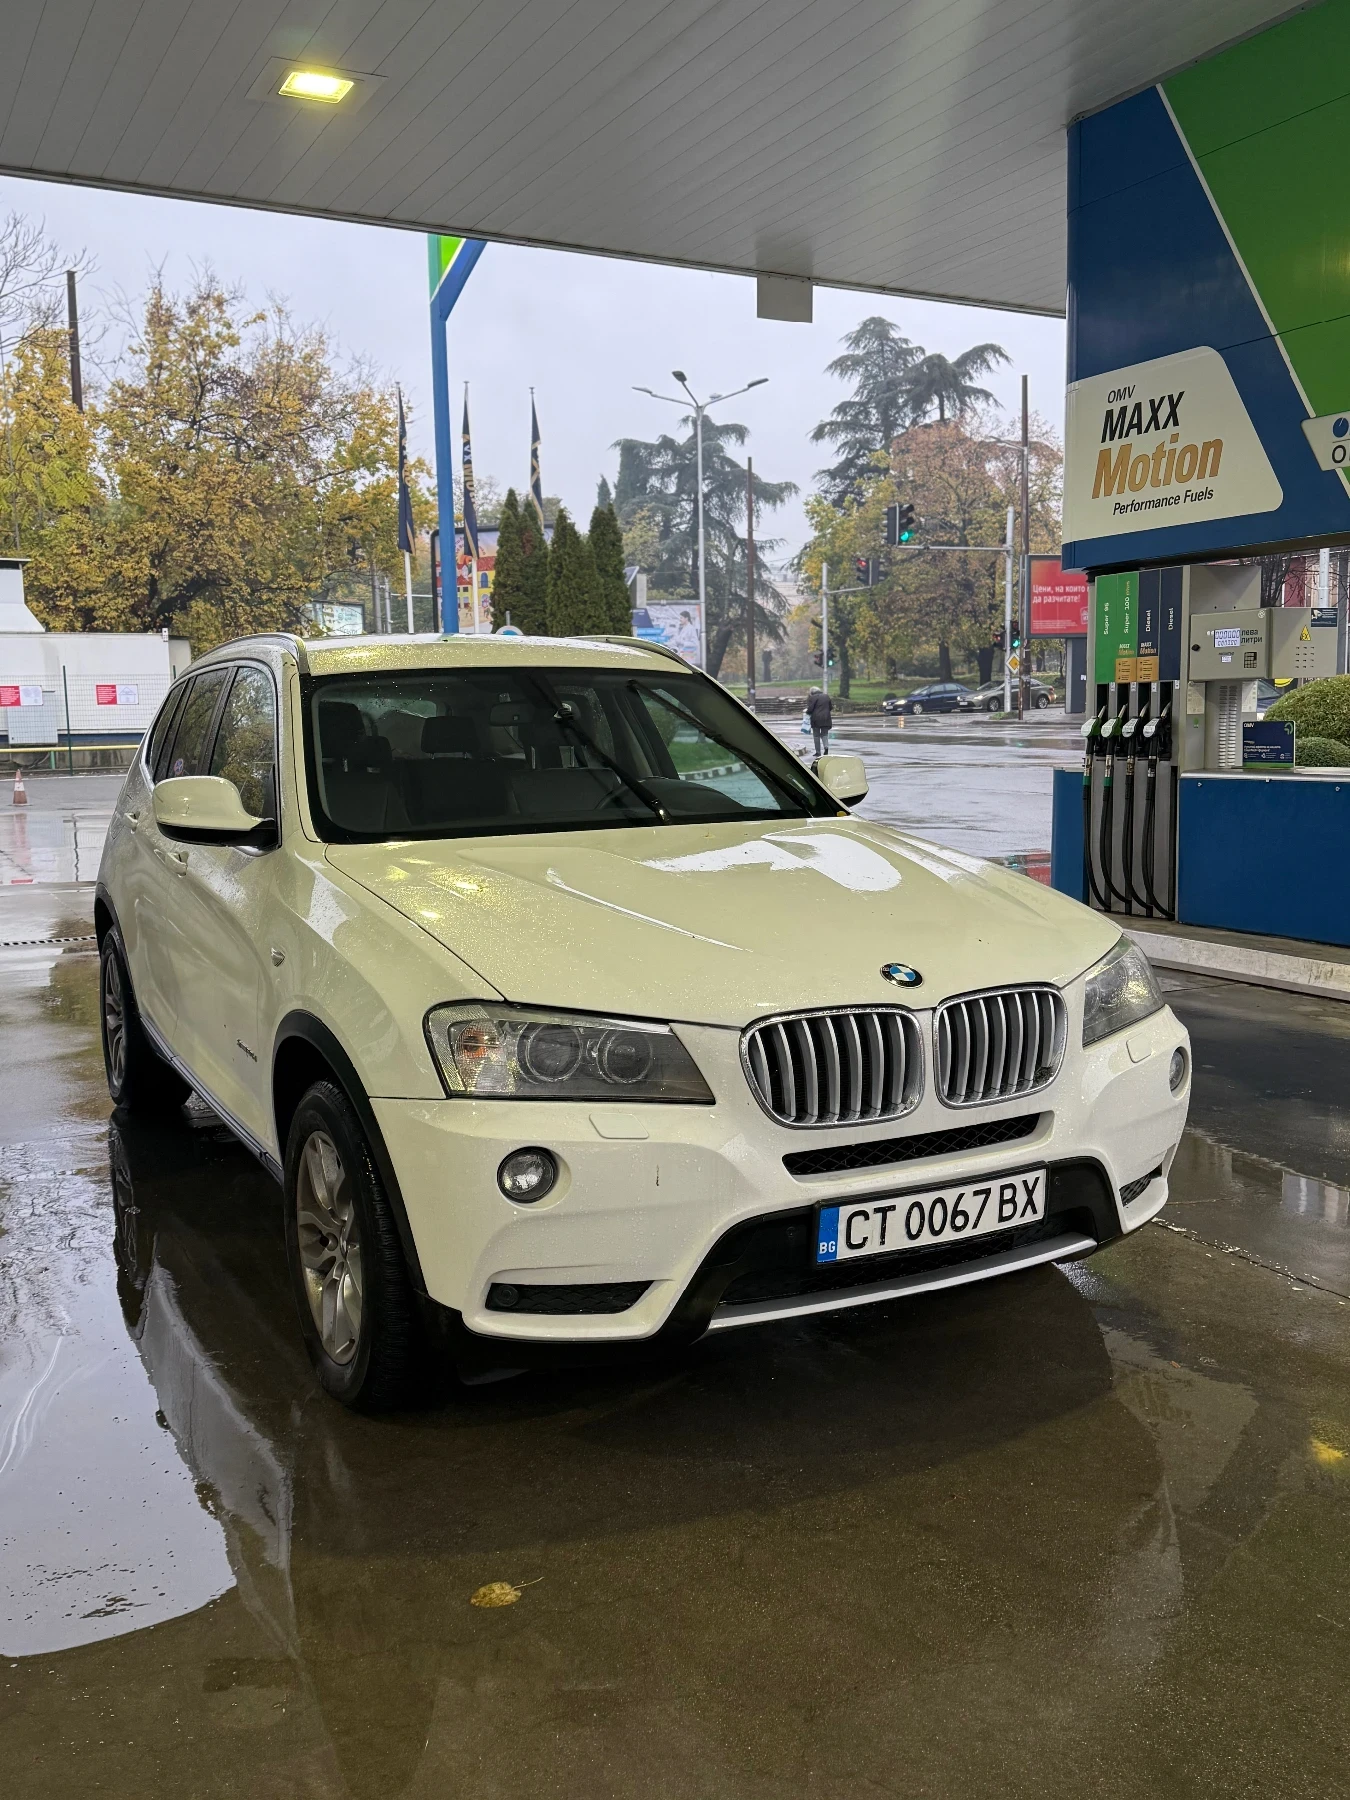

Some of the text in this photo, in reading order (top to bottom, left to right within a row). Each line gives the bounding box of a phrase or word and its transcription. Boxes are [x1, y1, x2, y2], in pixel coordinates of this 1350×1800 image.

[1107, 385, 1136, 404] OMV
[1100, 390, 1186, 444] MAXX
[1091, 432, 1224, 500] Motion
[1112, 486, 1214, 516] Performance Fuels
[1032, 585, 1054, 594] Цени,
[1032, 595, 1081, 604] да разчитате!
[1240, 636, 1263, 644] литри
[845, 1176, 1041, 1250] CT 0067 BX
[818, 1240, 836, 1255] BG
